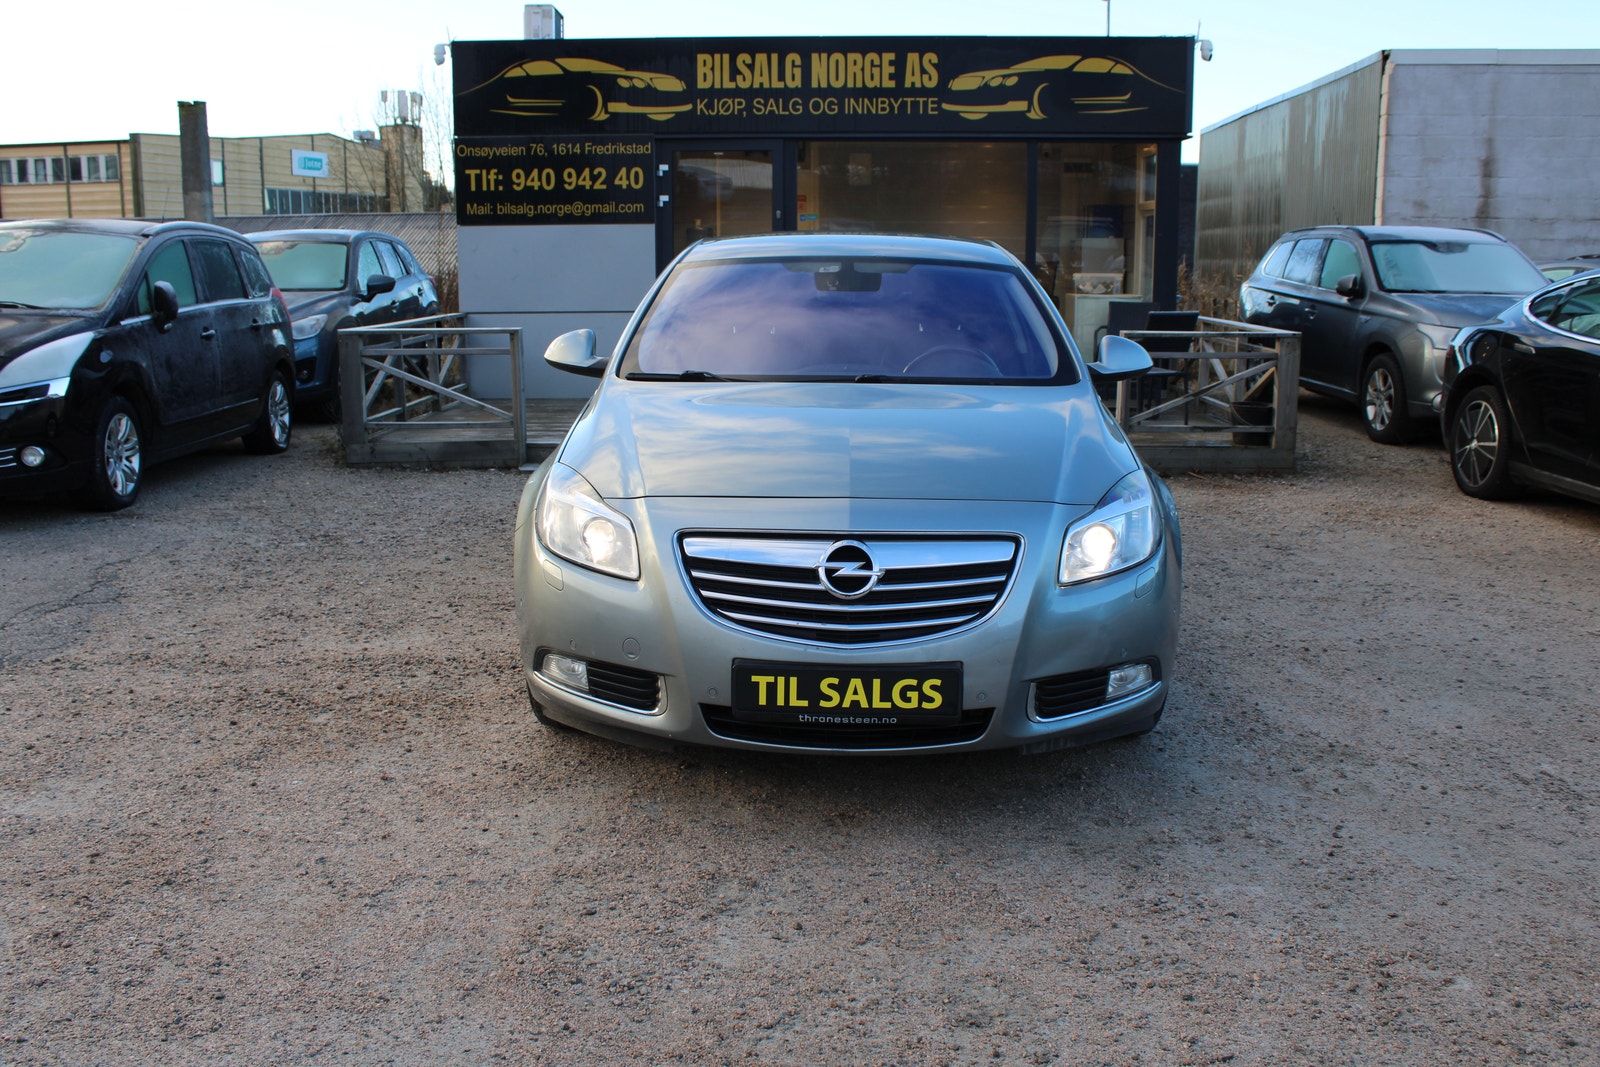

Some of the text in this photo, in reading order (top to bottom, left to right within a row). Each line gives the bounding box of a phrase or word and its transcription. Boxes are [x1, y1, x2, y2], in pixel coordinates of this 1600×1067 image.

[697, 53, 939, 89] BILSALG NORGE AS
[697, 97, 939, 118] KJØP, SALG OG INNBYTTE
[457, 142, 651, 159] Onsøyveien 76, 1614 Fredrikstad
[465, 167, 644, 191] Tlf: 940 942 40
[466, 201, 645, 217] Mail: bilsalg.norge@gmail.com
[751, 675, 943, 709] TIL SALGS
[798, 714, 897, 724] thranesteen.no
